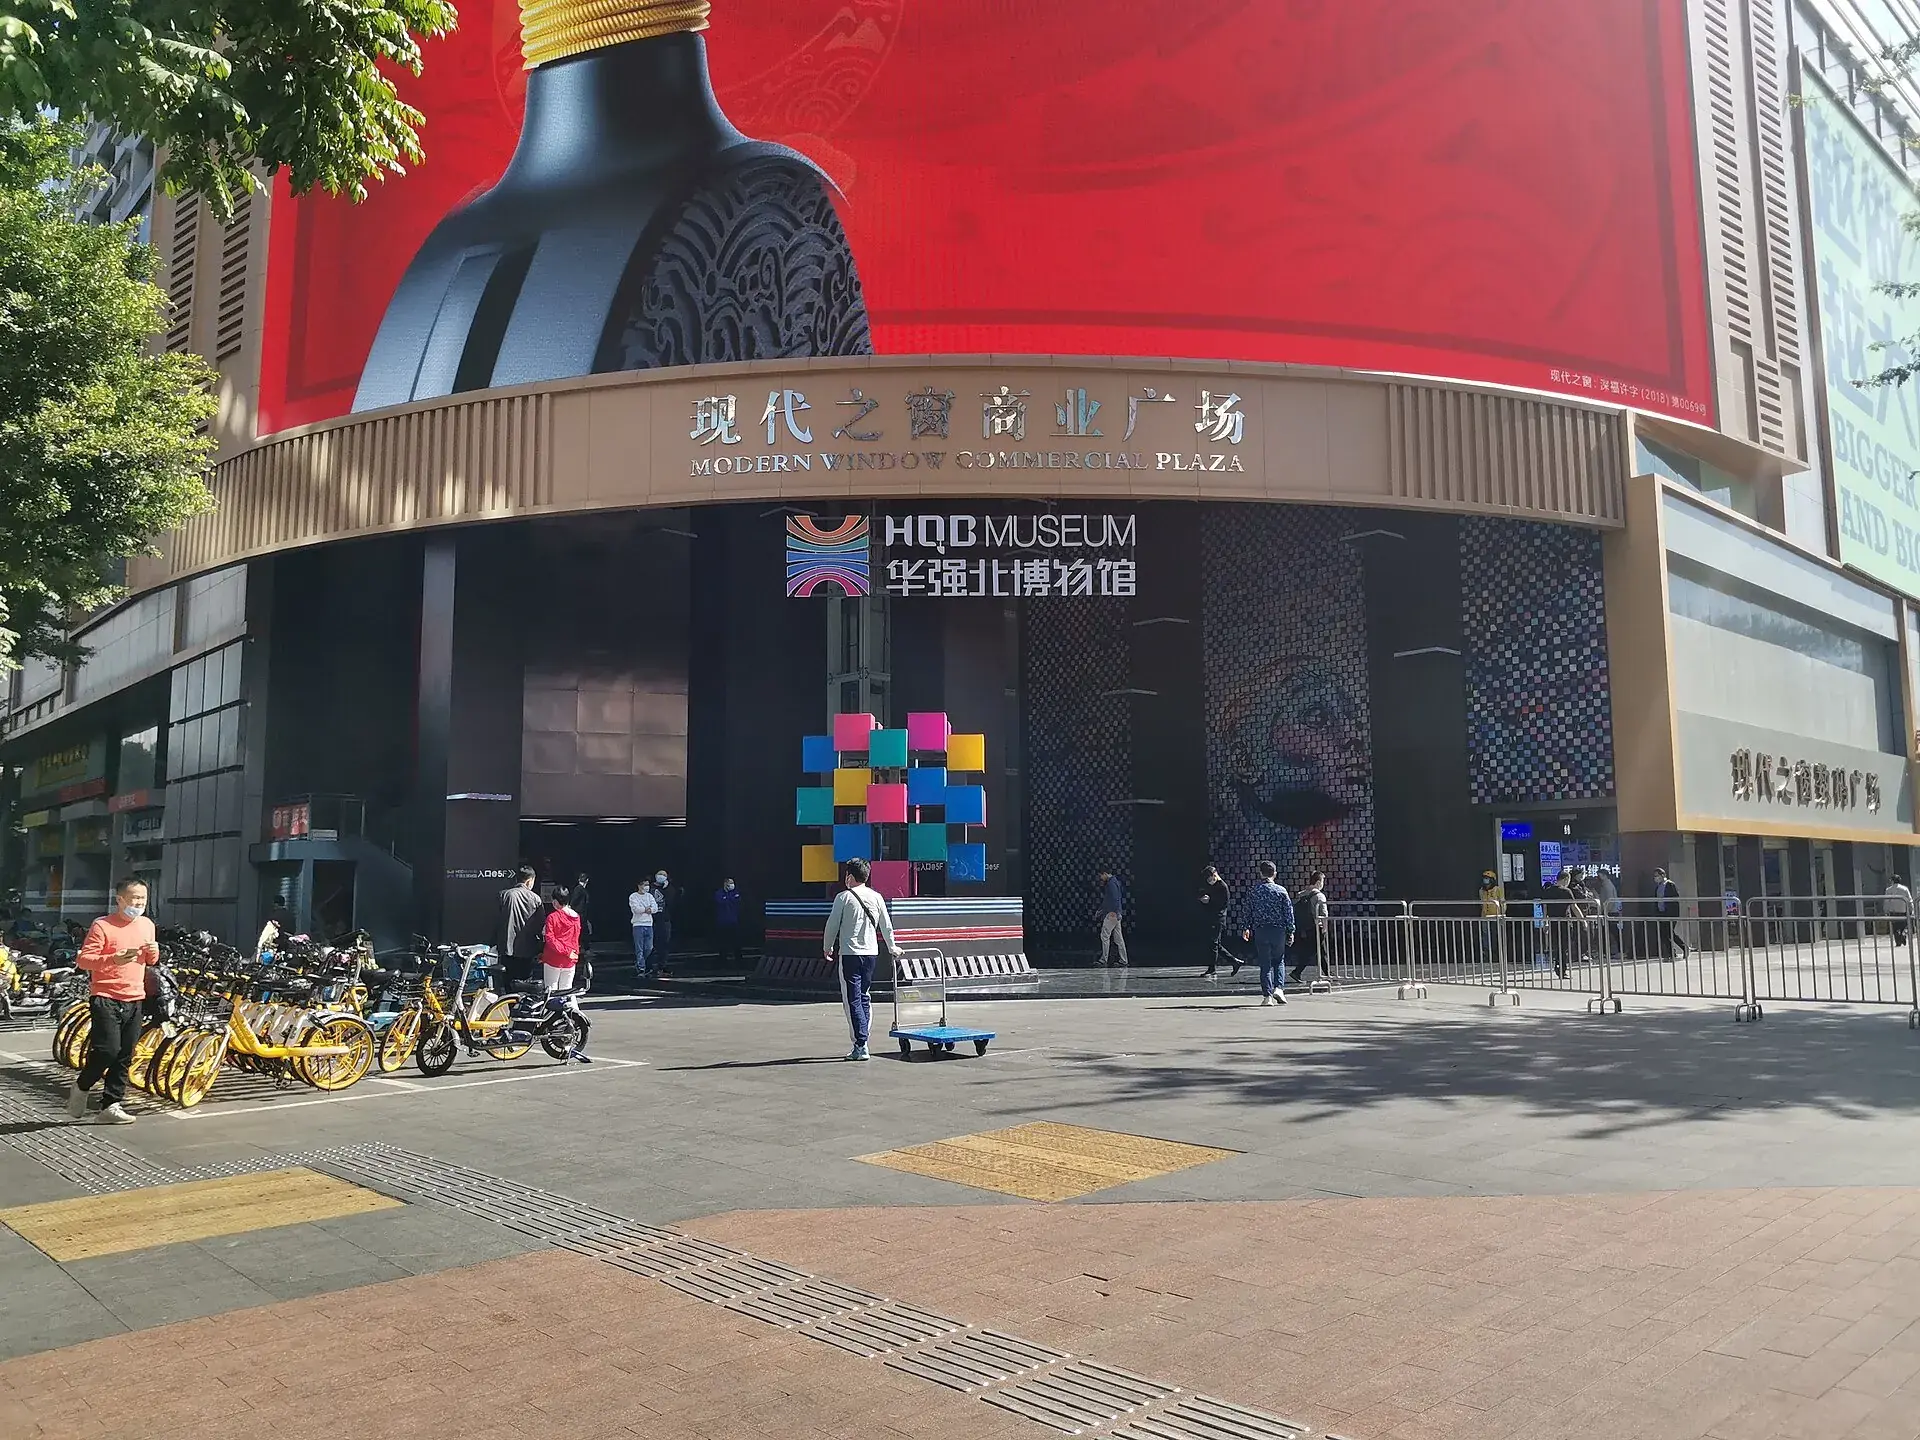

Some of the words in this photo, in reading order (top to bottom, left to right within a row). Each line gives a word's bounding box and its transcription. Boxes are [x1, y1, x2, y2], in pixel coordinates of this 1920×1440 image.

[689, 386, 1246, 446] 现代之窗商业广场
[689, 453, 812, 478] MODERN
[820, 451, 948, 473] WINDOW
[955, 451, 1149, 471] COMMERCIAL
[1156, 452, 1246, 473] PLAZA
[1832, 408, 1919, 512] BIGGER
[886, 515, 977, 554] HQB
[984, 515, 1136, 547] MUSEUM
[1840, 485, 1888, 556] AND
[886, 559, 1136, 597] 华强北博物馆
